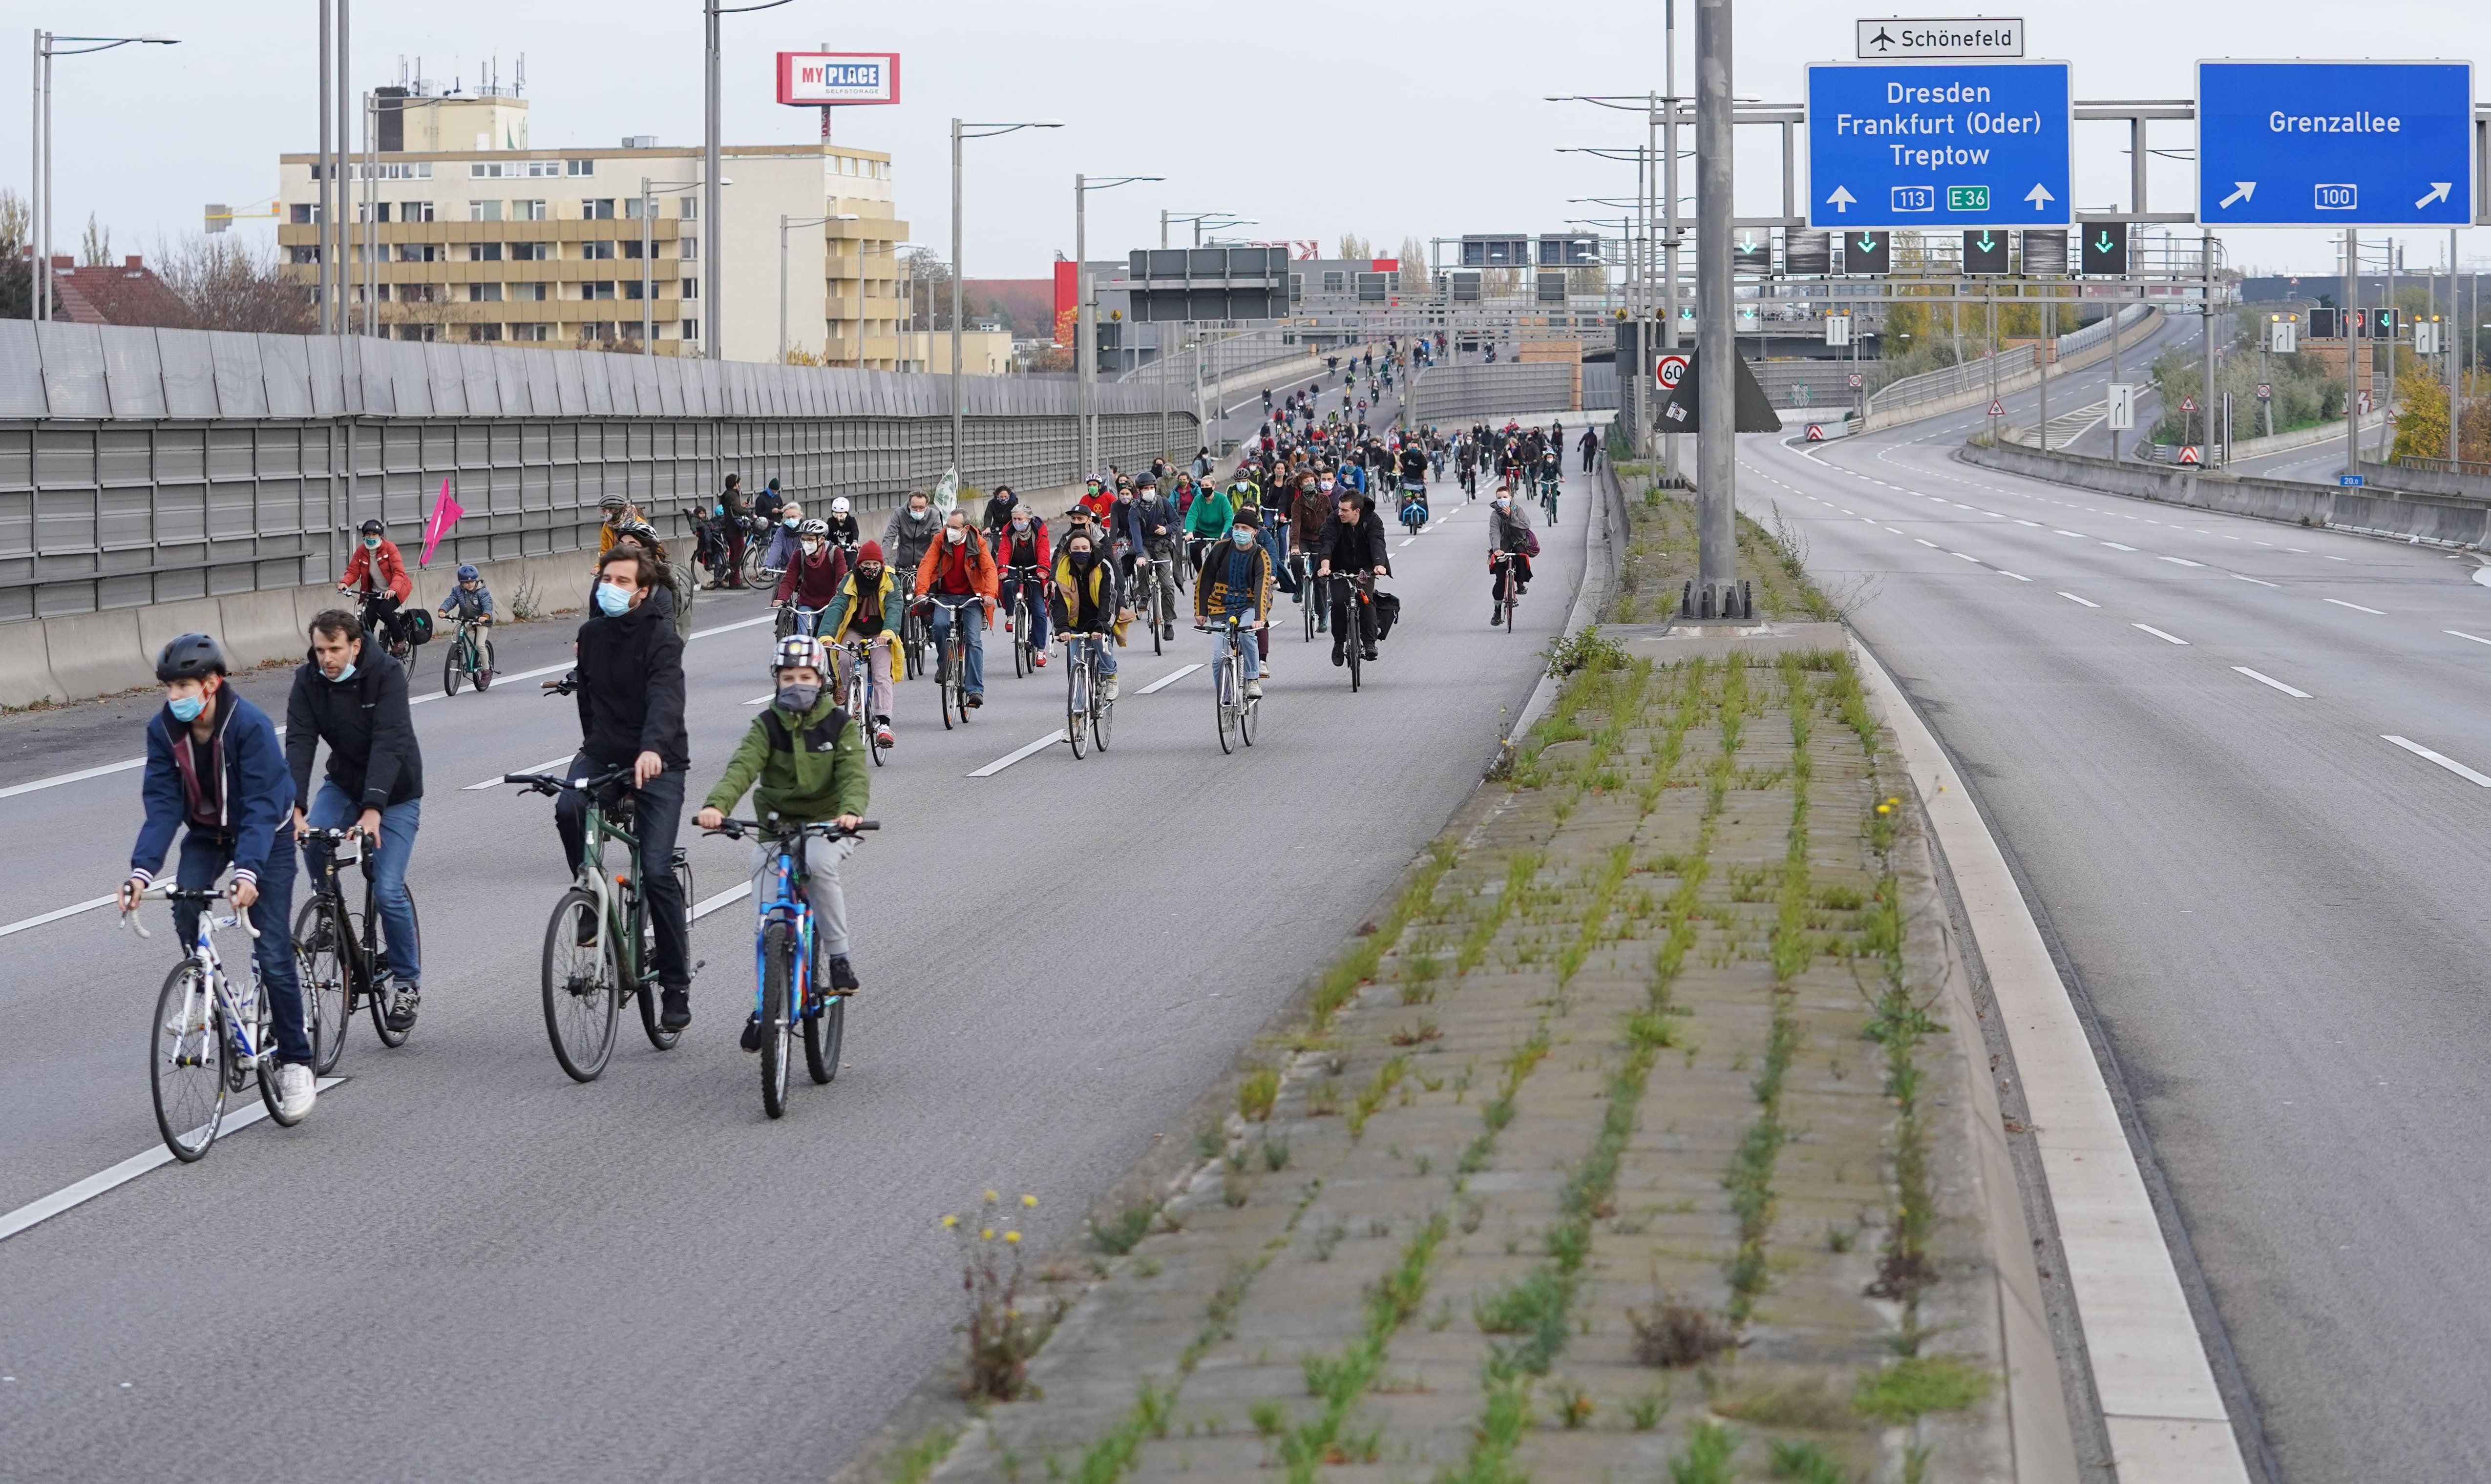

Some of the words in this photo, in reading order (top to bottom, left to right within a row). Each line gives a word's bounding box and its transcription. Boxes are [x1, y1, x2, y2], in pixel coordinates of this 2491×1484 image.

[1902, 29, 2011, 47] Schönefeld
[802, 67, 823, 83] MY
[828, 67, 877, 84] PLACE
[1888, 82, 1990, 103] Dresden
[1837, 113, 1954, 135] Frankfurt
[1967, 111, 2041, 135] (Oder)
[2270, 111, 2400, 132] Grenzallee
[1890, 145, 1989, 170] Treptow
[1900, 191, 1925, 207] 113
[2322, 188, 2349, 205] 100
[1664, 365, 1682, 380] 60
